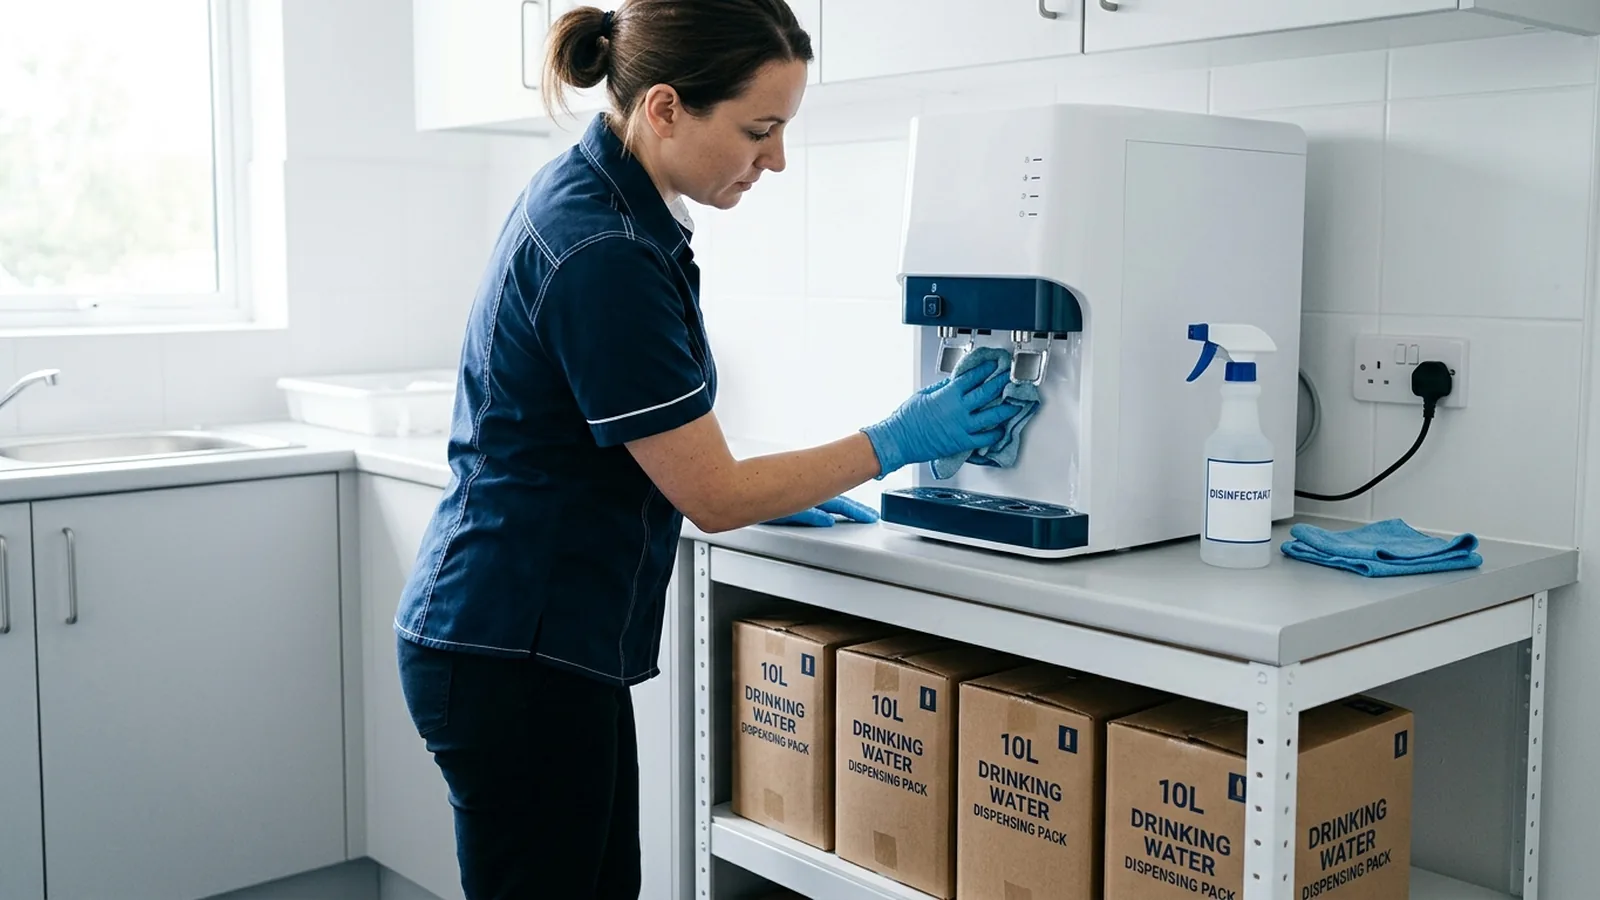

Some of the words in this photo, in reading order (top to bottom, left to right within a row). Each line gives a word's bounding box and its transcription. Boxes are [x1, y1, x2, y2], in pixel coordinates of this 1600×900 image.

[761, 662, 788, 687] 10L
[745, 685, 805, 718] DRINKING
[753, 706, 796, 734] WATER
[872, 695, 904, 722] 10L
[853, 719, 923, 756] DRINKING
[1001, 733, 1039, 764] 10L
[861, 742, 912, 773] WATER
[848, 759, 900, 787] DISPENSING
[902, 778, 928, 797] PACK
[978, 760, 1062, 802] DRINKING
[1159, 779, 1204, 814] 10L
[990, 784, 1050, 821] WATER
[1037, 825, 1067, 847] PACK
[1131, 807, 1231, 856] DRINKING
[1309, 798, 1387, 849] DRINKING
[1144, 835, 1215, 876] WATER
[1320, 829, 1376, 871] WATER
[1125, 855, 1198, 892] DISPENSING
[1201, 881, 1236, 900] PACK
[1302, 863, 1364, 900] DISPENSING
